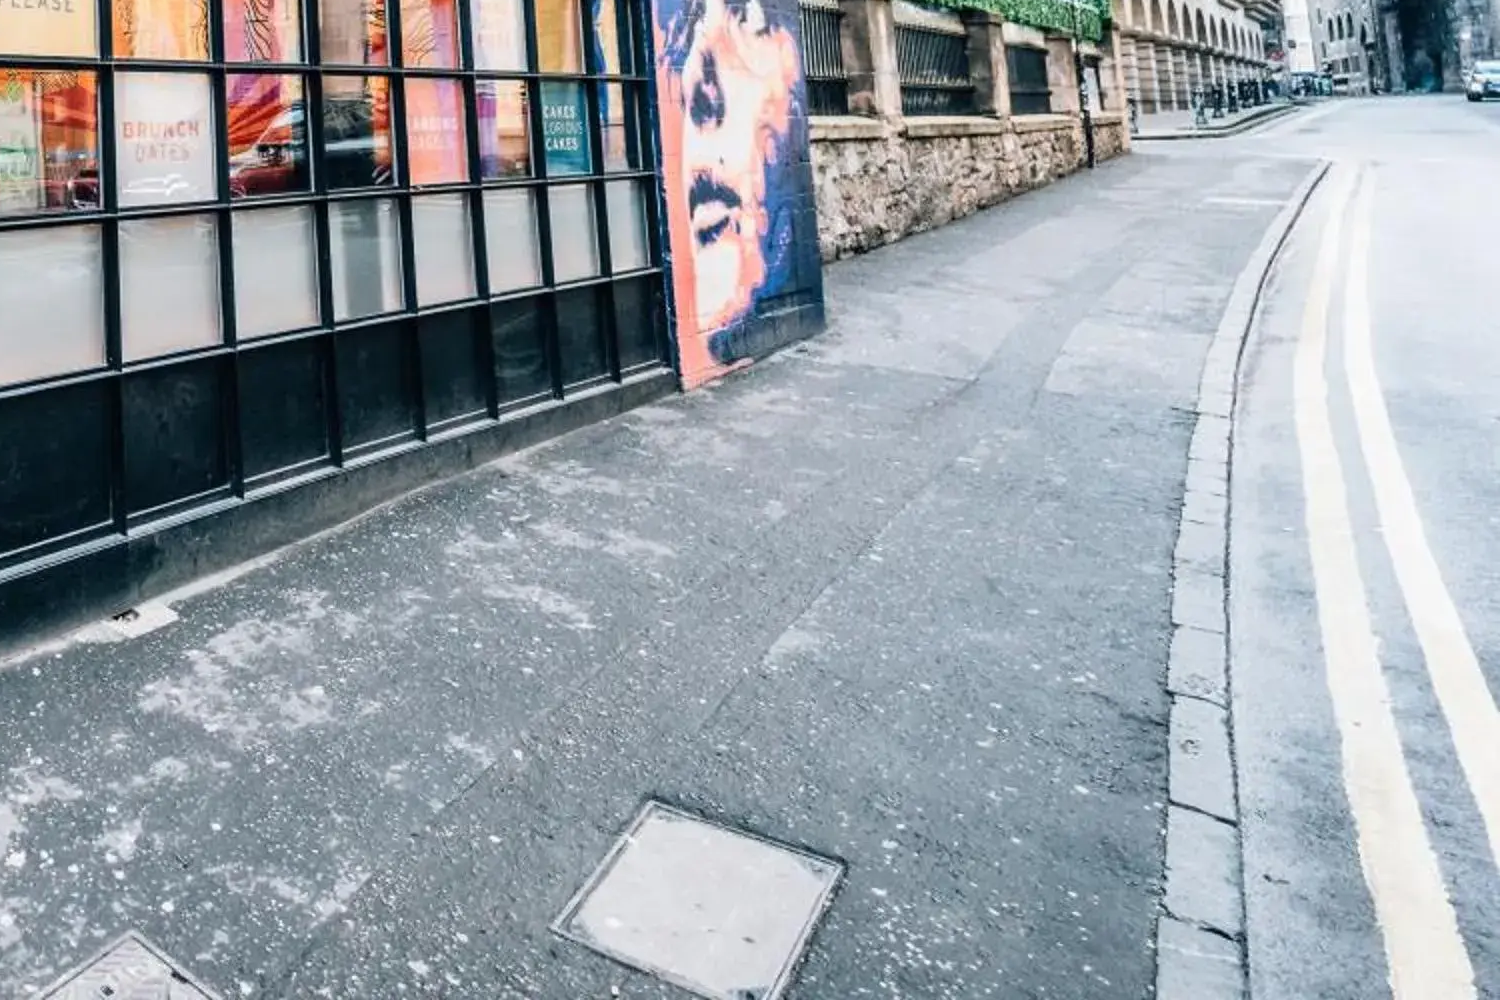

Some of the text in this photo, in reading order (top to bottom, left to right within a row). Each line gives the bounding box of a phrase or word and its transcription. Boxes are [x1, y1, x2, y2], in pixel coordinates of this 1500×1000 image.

[543, 105, 576, 119] CAKES
[122, 120, 199, 139] BRUNCH
[545, 137, 578, 151] CAKES
